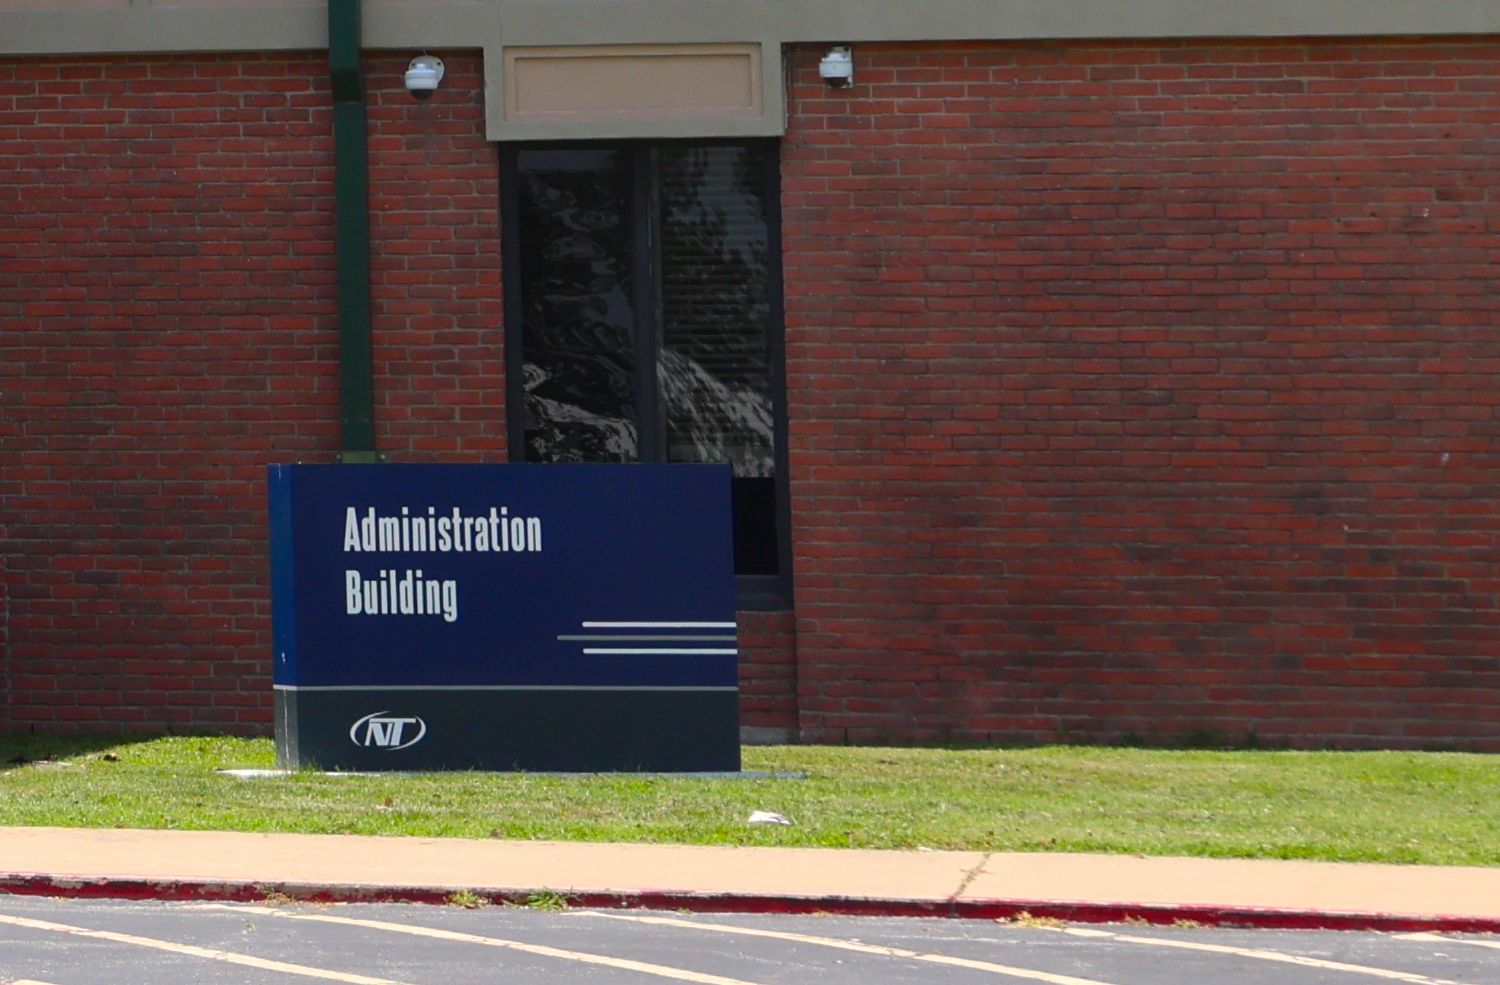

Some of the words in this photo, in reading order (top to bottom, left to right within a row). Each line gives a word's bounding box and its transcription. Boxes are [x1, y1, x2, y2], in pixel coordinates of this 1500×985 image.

[343, 506, 542, 552] Administration
[345, 569, 458, 623] Building
[363, 717, 417, 747] NT
